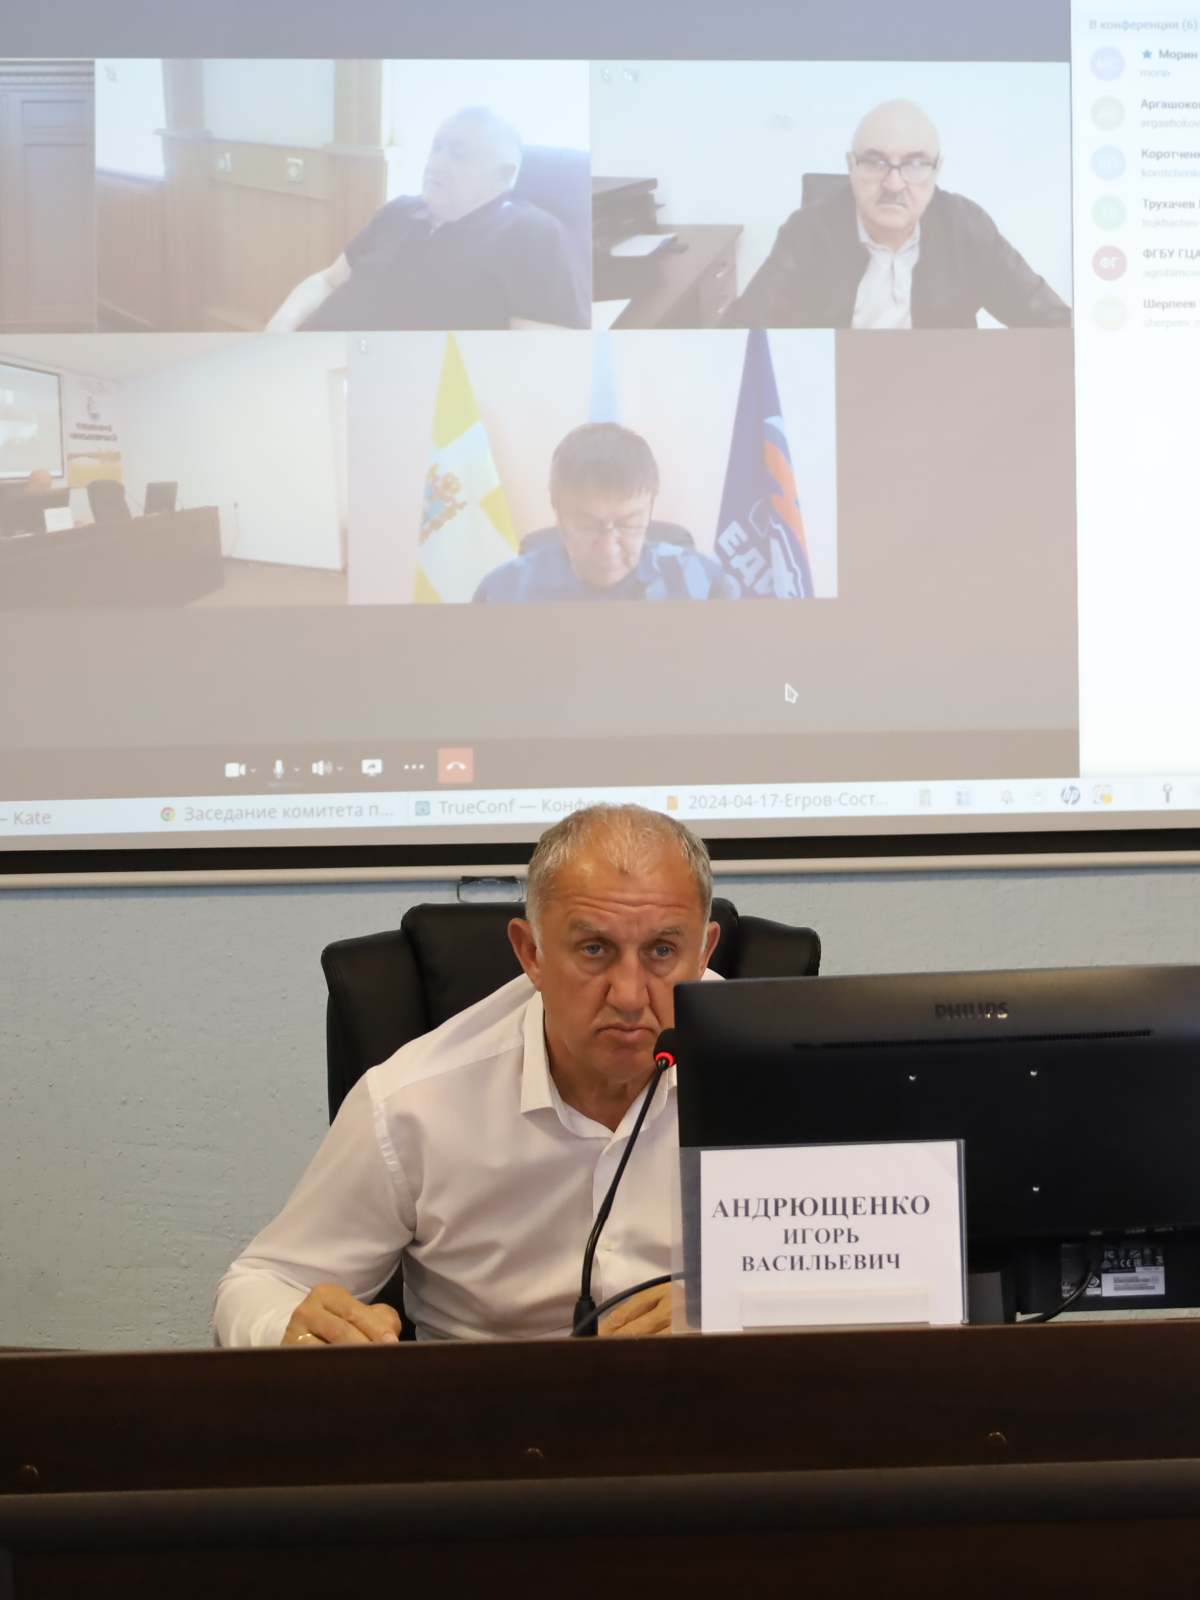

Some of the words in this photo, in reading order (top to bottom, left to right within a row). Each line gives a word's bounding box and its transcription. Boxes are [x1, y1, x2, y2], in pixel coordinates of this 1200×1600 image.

[1100, 19, 1179, 31] конференции
[1182, 19, 1198, 31] (6)
[1159, 50, 1198, 62] Морин
[1140, 69, 1170, 78] morin
[1141, 118, 1200, 130] argashokov
[1143, 199, 1195, 212] Трухачев
[1142, 218, 1199, 228] trukhachev
[1143, 249, 1174, 259] ФГБУ
[1099, 256, 1119, 270] ФГ
[1143, 299, 1196, 311] Шерпеев
[184, 805, 277, 824] Заседание
[282, 803, 363, 820] комитета
[439, 798, 516, 816] TrueConf
[13, 810, 52, 826] Kate
[935, 1002, 1009, 1019] PHILIPS
[712, 1195, 931, 1222] АНДРЮЩЕНКО
[783, 1227, 860, 1245] ИГОРЬ
[741, 1252, 901, 1272] ВАСИЛЬЕВИЧ
